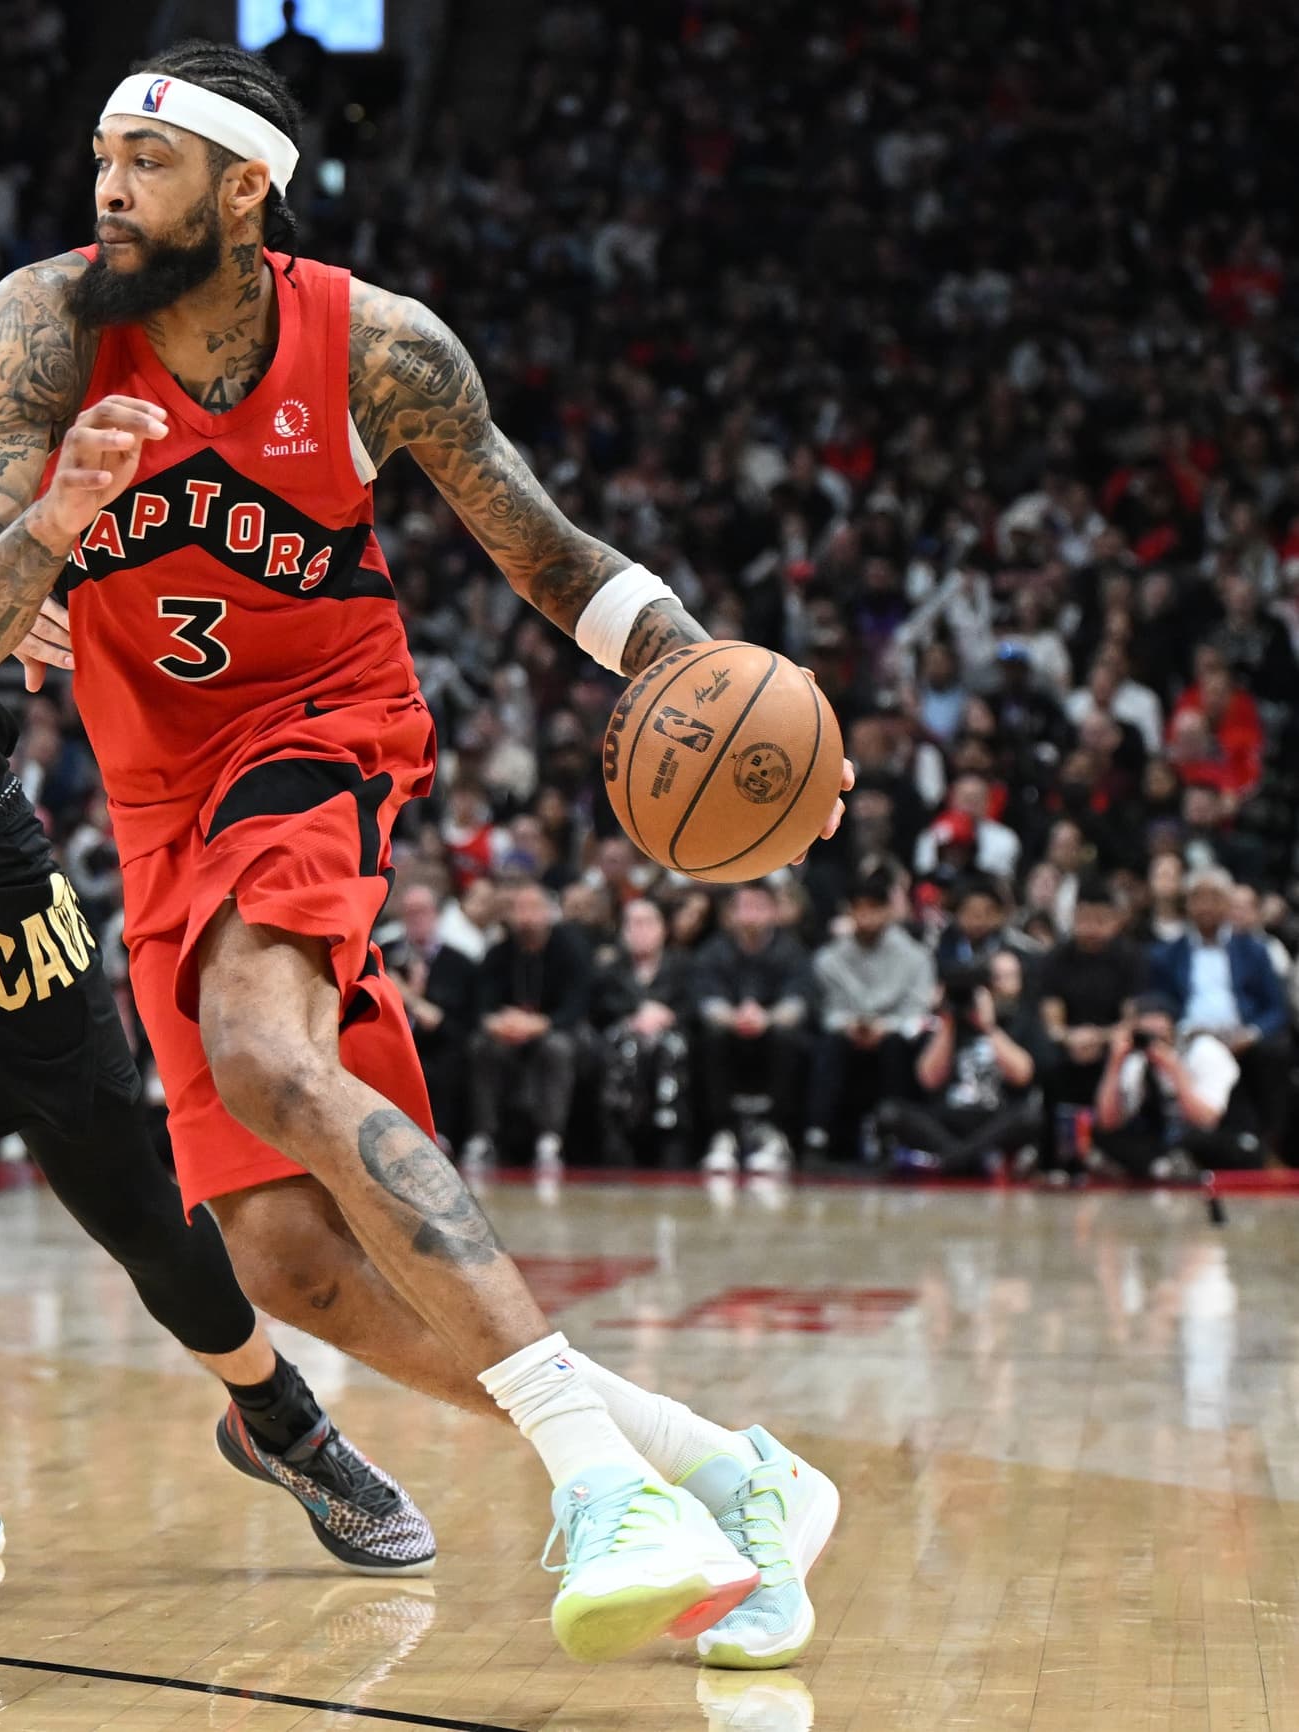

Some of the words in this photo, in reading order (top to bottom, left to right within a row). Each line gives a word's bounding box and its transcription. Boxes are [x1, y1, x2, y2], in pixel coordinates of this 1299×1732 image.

[263, 443, 290, 457] Sun
[291, 438, 319, 454] Life
[153, 596, 231, 682] 3
